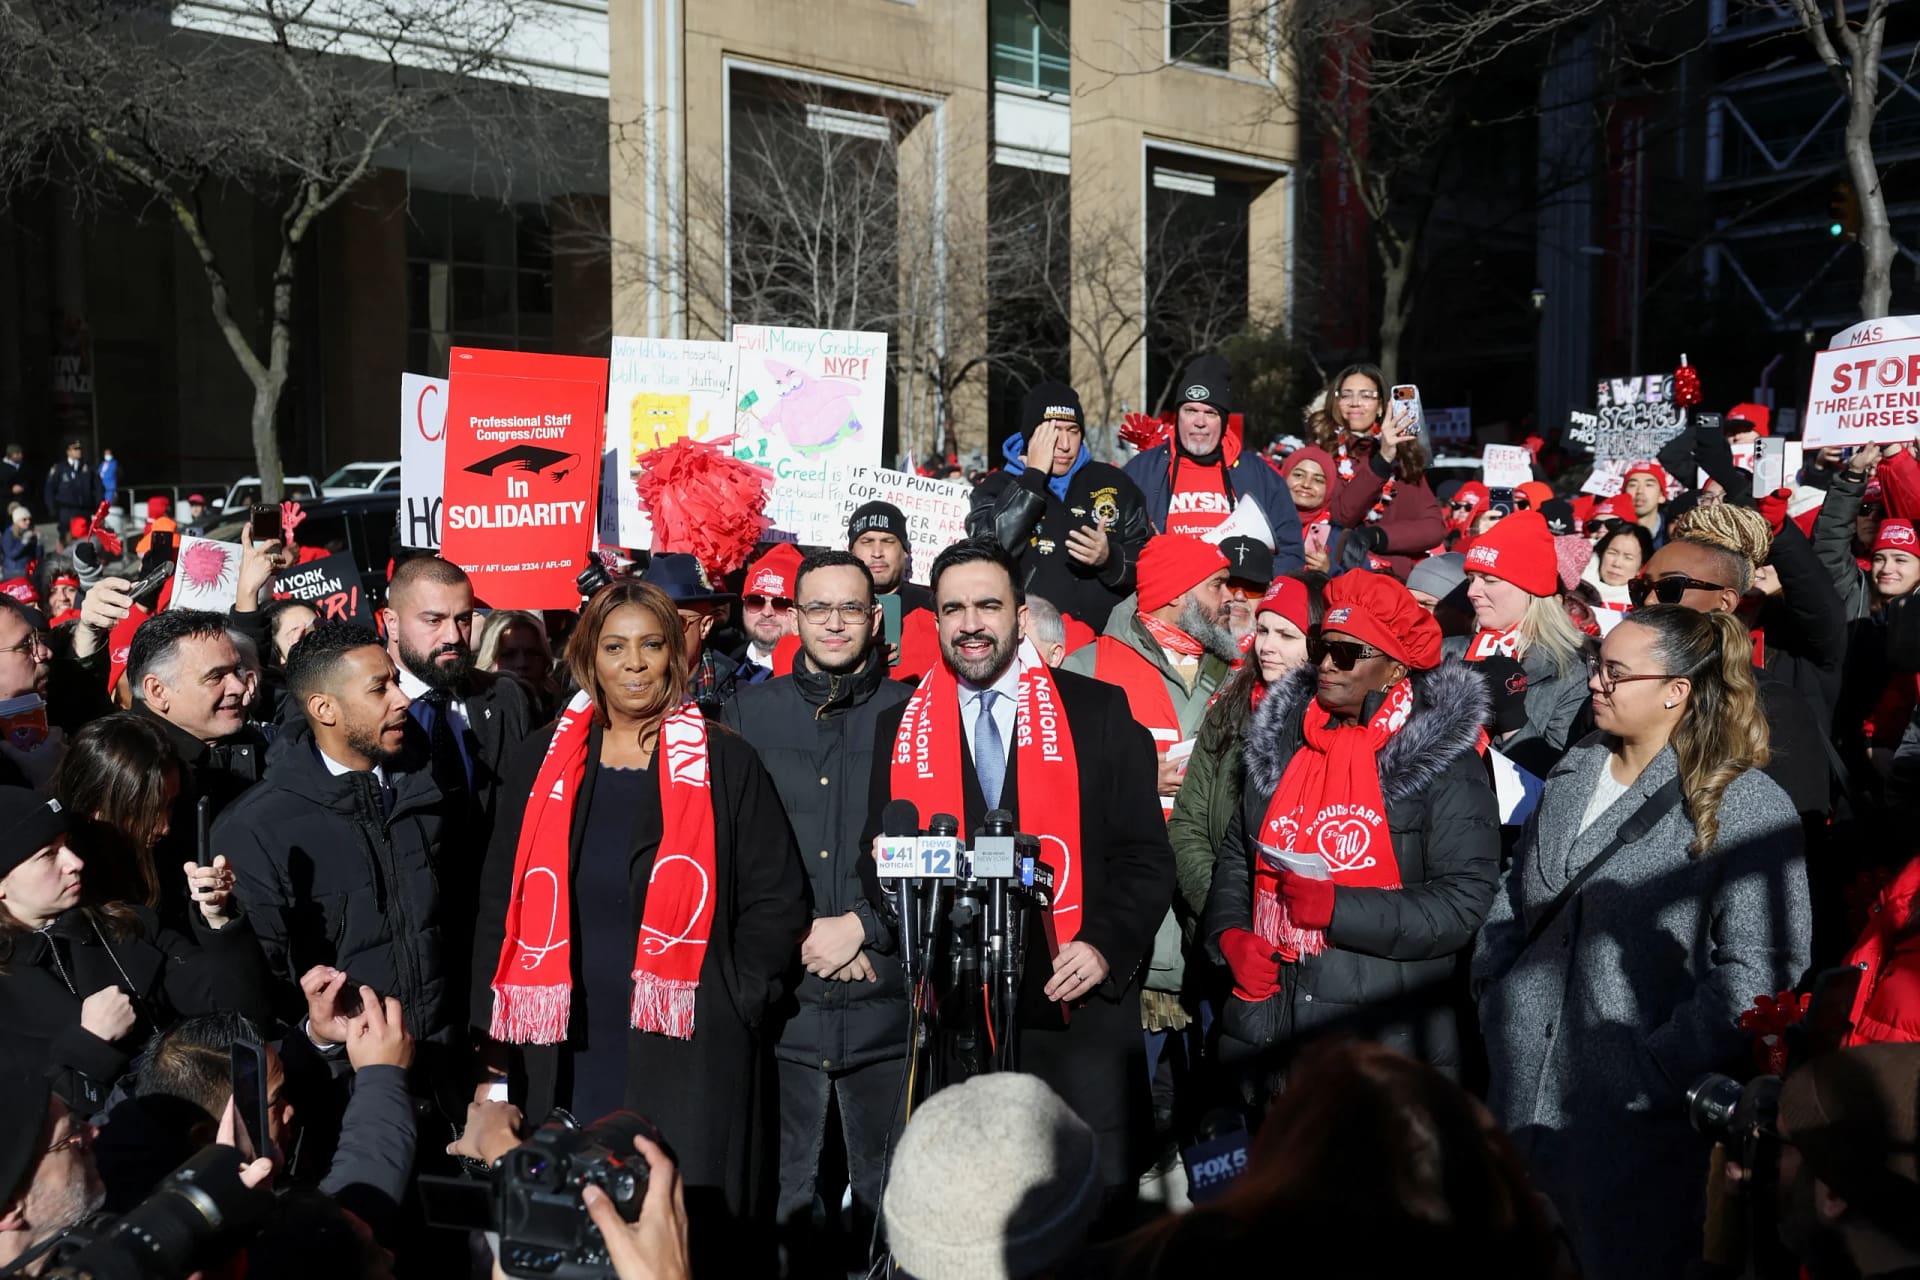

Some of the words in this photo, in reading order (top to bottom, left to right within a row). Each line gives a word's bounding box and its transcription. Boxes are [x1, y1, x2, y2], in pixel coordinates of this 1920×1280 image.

[769, 328, 816, 363] Money
[818, 331, 880, 358] Grubber
[1850, 325, 1883, 346] MÁS
[824, 356, 869, 380] NYP!
[470, 415, 541, 430] Professional
[544, 414, 572, 427] Staff
[1045, 405, 1076, 416] AMAZON
[1838, 409, 1919, 430] NURSES
[476, 427, 565, 442] Congress/CUNY
[776, 457, 827, 482] Greed
[507, 476, 529, 498] In
[853, 467, 868, 478] IF
[873, 471, 902, 486] YOU
[906, 477, 953, 497] PUNCH
[449, 500, 586, 529] SOLIDARITY
[885, 490, 962, 519] ARRESTED
[869, 513, 890, 529] CLUB
[486, 563, 500, 573] AFT
[501, 562, 520, 572] Local
[521, 561, 539, 571] 2334
[546, 559, 572, 569] AFL-CIO
[285, 567, 326, 590] YORK
[290, 577, 343, 600] TERIAN
[1017, 681, 1033, 748] Nurses
[1033, 675, 1063, 762] National
[898, 696, 922, 764] Nurses
[1349, 803, 1383, 827] CARE
[896, 846, 914, 861] 41
[921, 840, 952, 848] news
[1335, 829, 1361, 860] All
[921, 849, 951, 874] 12
[1192, 1153, 1232, 1183] FOX
[1233, 1148, 1248, 1168] 5
